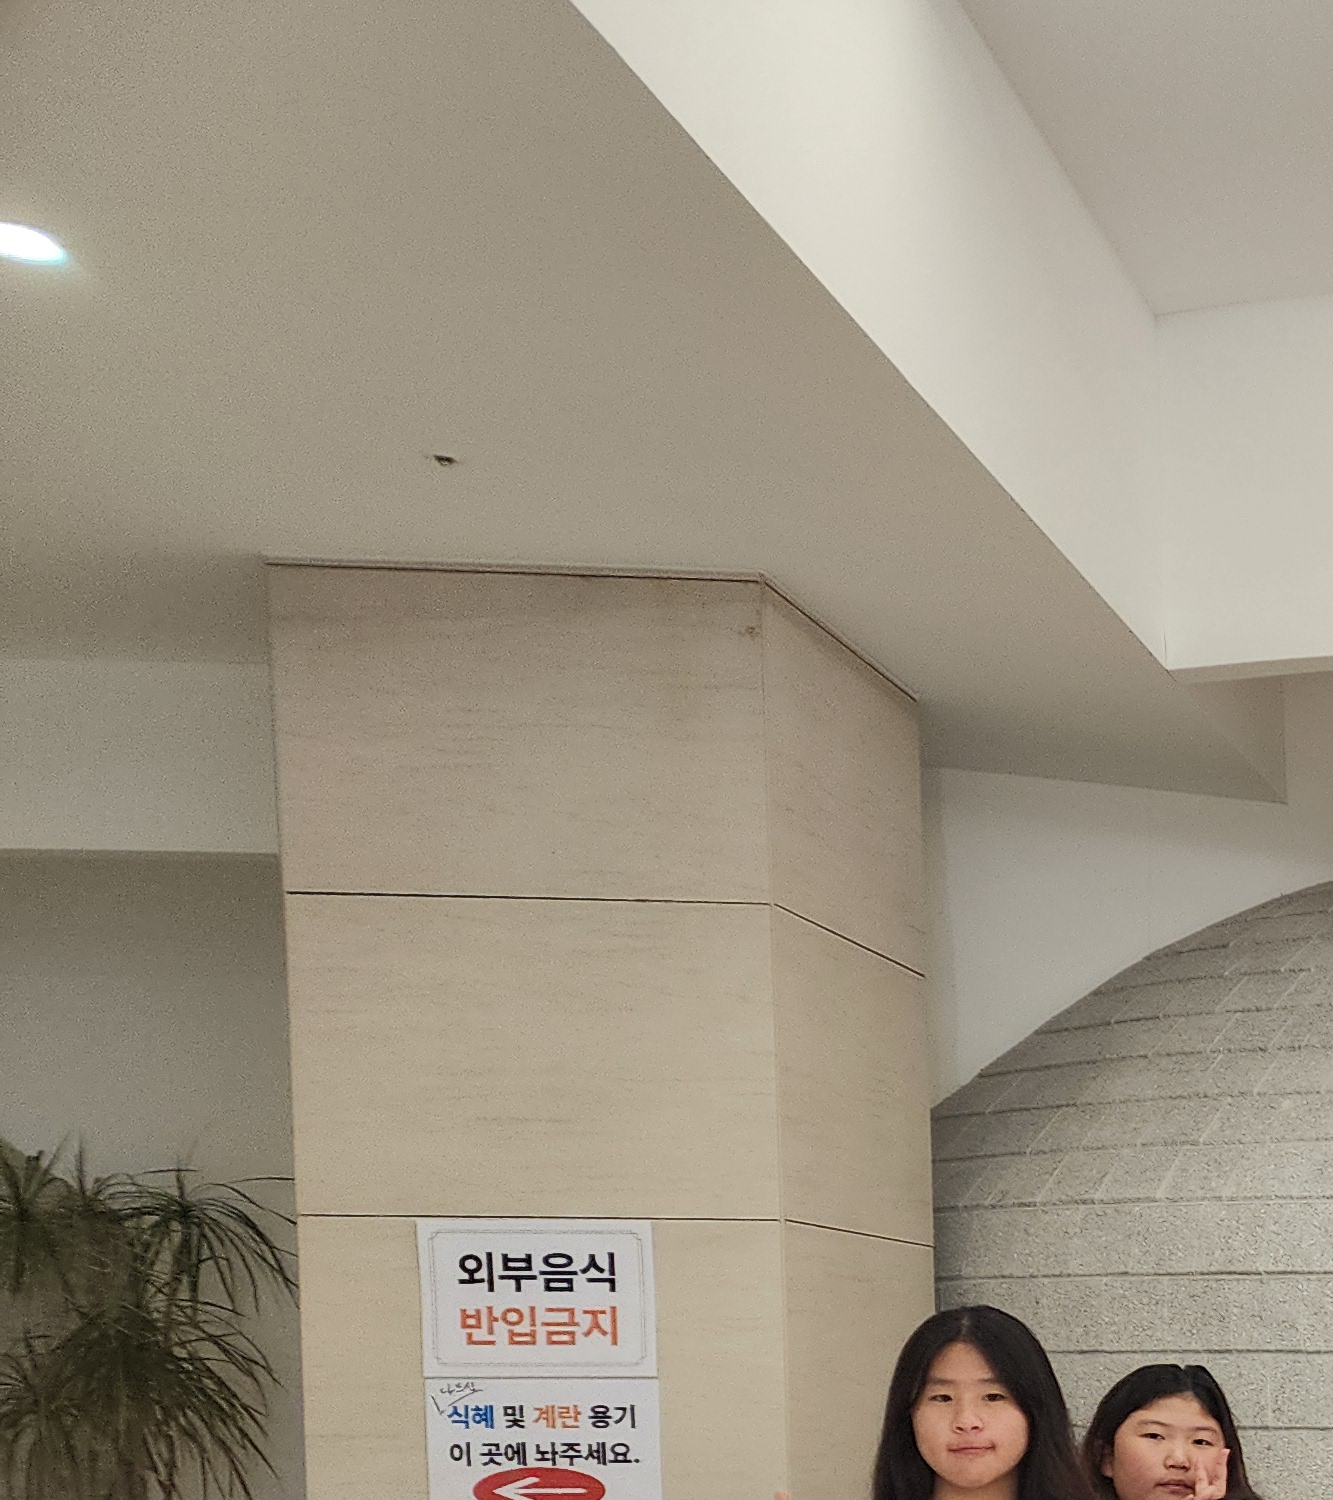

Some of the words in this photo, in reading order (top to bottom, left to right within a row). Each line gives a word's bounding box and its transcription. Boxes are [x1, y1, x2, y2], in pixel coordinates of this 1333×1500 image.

[457, 1251, 617, 1293] 외부음식
[459, 1305, 619, 1346] 반입금지
[447, 1404, 495, 1429] 식혜
[502, 1405, 525, 1429] 및
[532, 1404, 581, 1429] 계란
[588, 1404, 637, 1429] 용기
[449, 1442, 472, 1467] 이
[479, 1442, 528, 1467] 곳에
[533, 1442, 641, 1467] 놔주세요.
